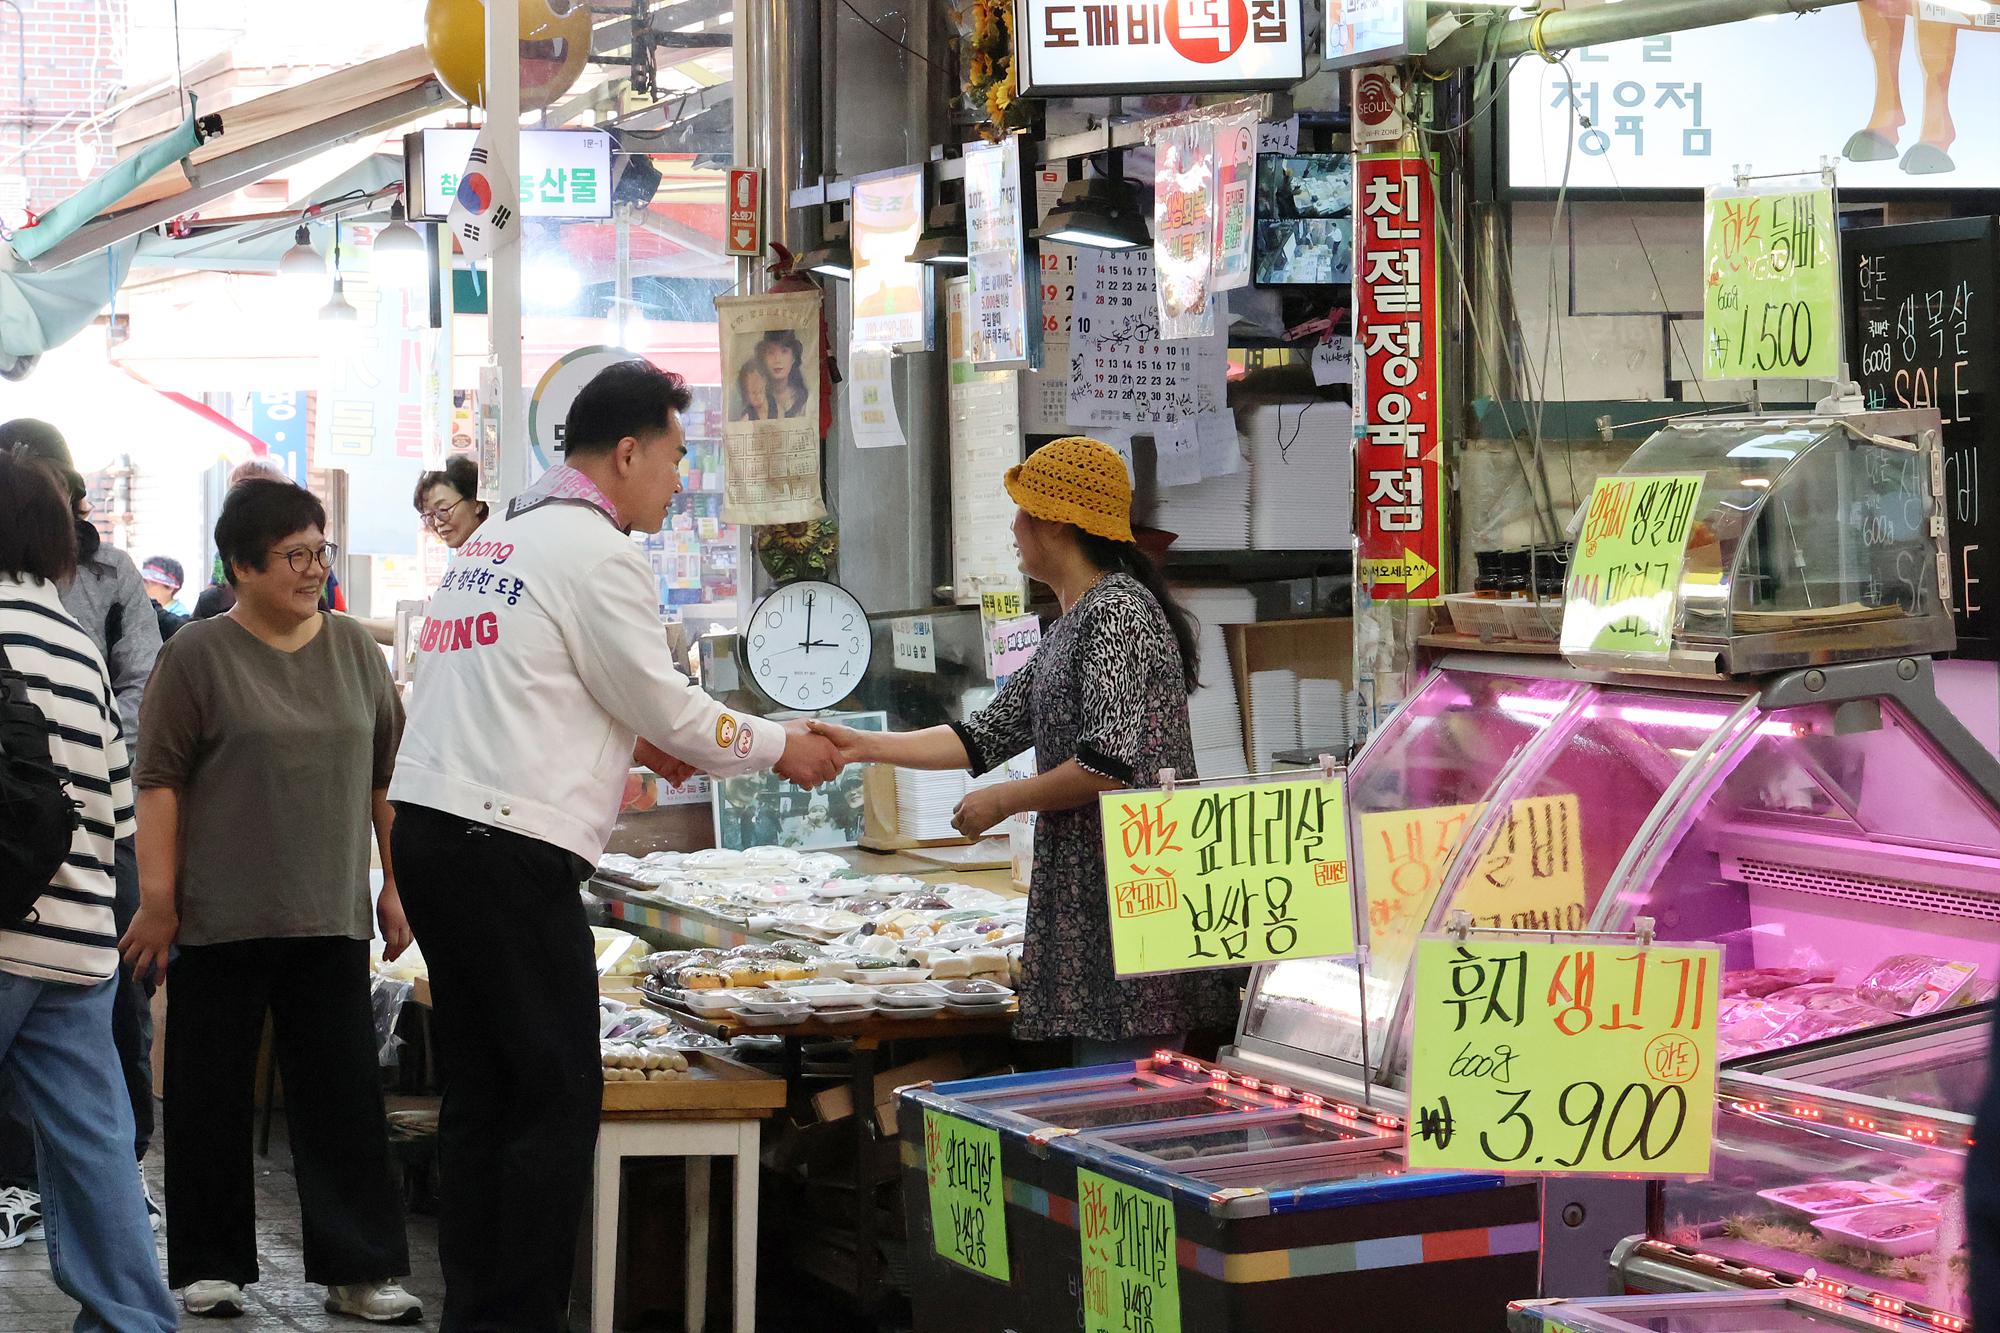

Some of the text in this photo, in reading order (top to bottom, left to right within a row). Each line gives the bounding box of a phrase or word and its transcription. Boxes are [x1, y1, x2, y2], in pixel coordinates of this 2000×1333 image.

[1358, 101, 1391, 115] SEOUL
[1551, 81, 1711, 157] 정육점
[1381, 128, 1398, 136] ZONE
[732, 210, 755, 221] 소화기
[1040, 256, 1057, 270] 12
[1109, 267, 1118, 275] 15
[1123, 267, 1132, 275] 16
[1138, 267, 1147, 276] 17
[1096, 280, 1147, 291] 21 22 23 24
[1859, 254, 1887, 302] 한돈
[1041, 285, 1057, 300] 19
[1096, 296, 1132, 306] 28 29 30
[1717, 285, 1738, 311] 600g
[1078, 318, 1090, 333] 10
[1868, 320, 1890, 338] 국내산
[1897, 280, 1974, 362] 생목살
[1097, 344, 1102, 352] 5
[1125, 345, 1129, 353] 7
[1139, 345, 1144, 354] 8
[1154, 346, 1159, 354] 9
[1166, 347, 1176, 355] 10
[1364, 175, 1424, 532] 친절정육점
[1095, 359, 1190, 371] 12 13 14 15 16 17 18
[1863, 342, 1891, 376] 600g
[1095, 374, 1175, 385] 19 20 21 22 23 24
[1095, 390, 1175, 401] 26 27 28 29 30 31
[1895, 360, 1971, 425] SALE
[1631, 478, 1698, 547] 생갈비
[458, 567, 495, 594] 행복한
[494, 578, 524, 606] 도봉
[782, 596, 792, 612] 11
[802, 589, 816, 606] 12
[1004, 594, 1020, 613] 만두
[765, 611, 782, 628] 10
[841, 614, 853, 631] 2
[753, 635, 765, 652] 9
[849, 637, 859, 654] 3
[760, 658, 771, 676] 8
[839, 660, 849, 677] 4
[778, 676, 788, 693] 7
[798, 683, 809, 700] 6
[822, 677, 833, 694] 5
[1191, 787, 1335, 877] 앞다리살
[1119, 880, 1176, 912] 암돼지
[1443, 946, 1707, 1036] 후지 생고기
[1449, 1041, 1520, 1083] 600g
[1653, 1041, 1691, 1079] 한돈
[945, 1128, 996, 1208] 앞다리살
[1113, 1187, 1172, 1289] 앞다리살
